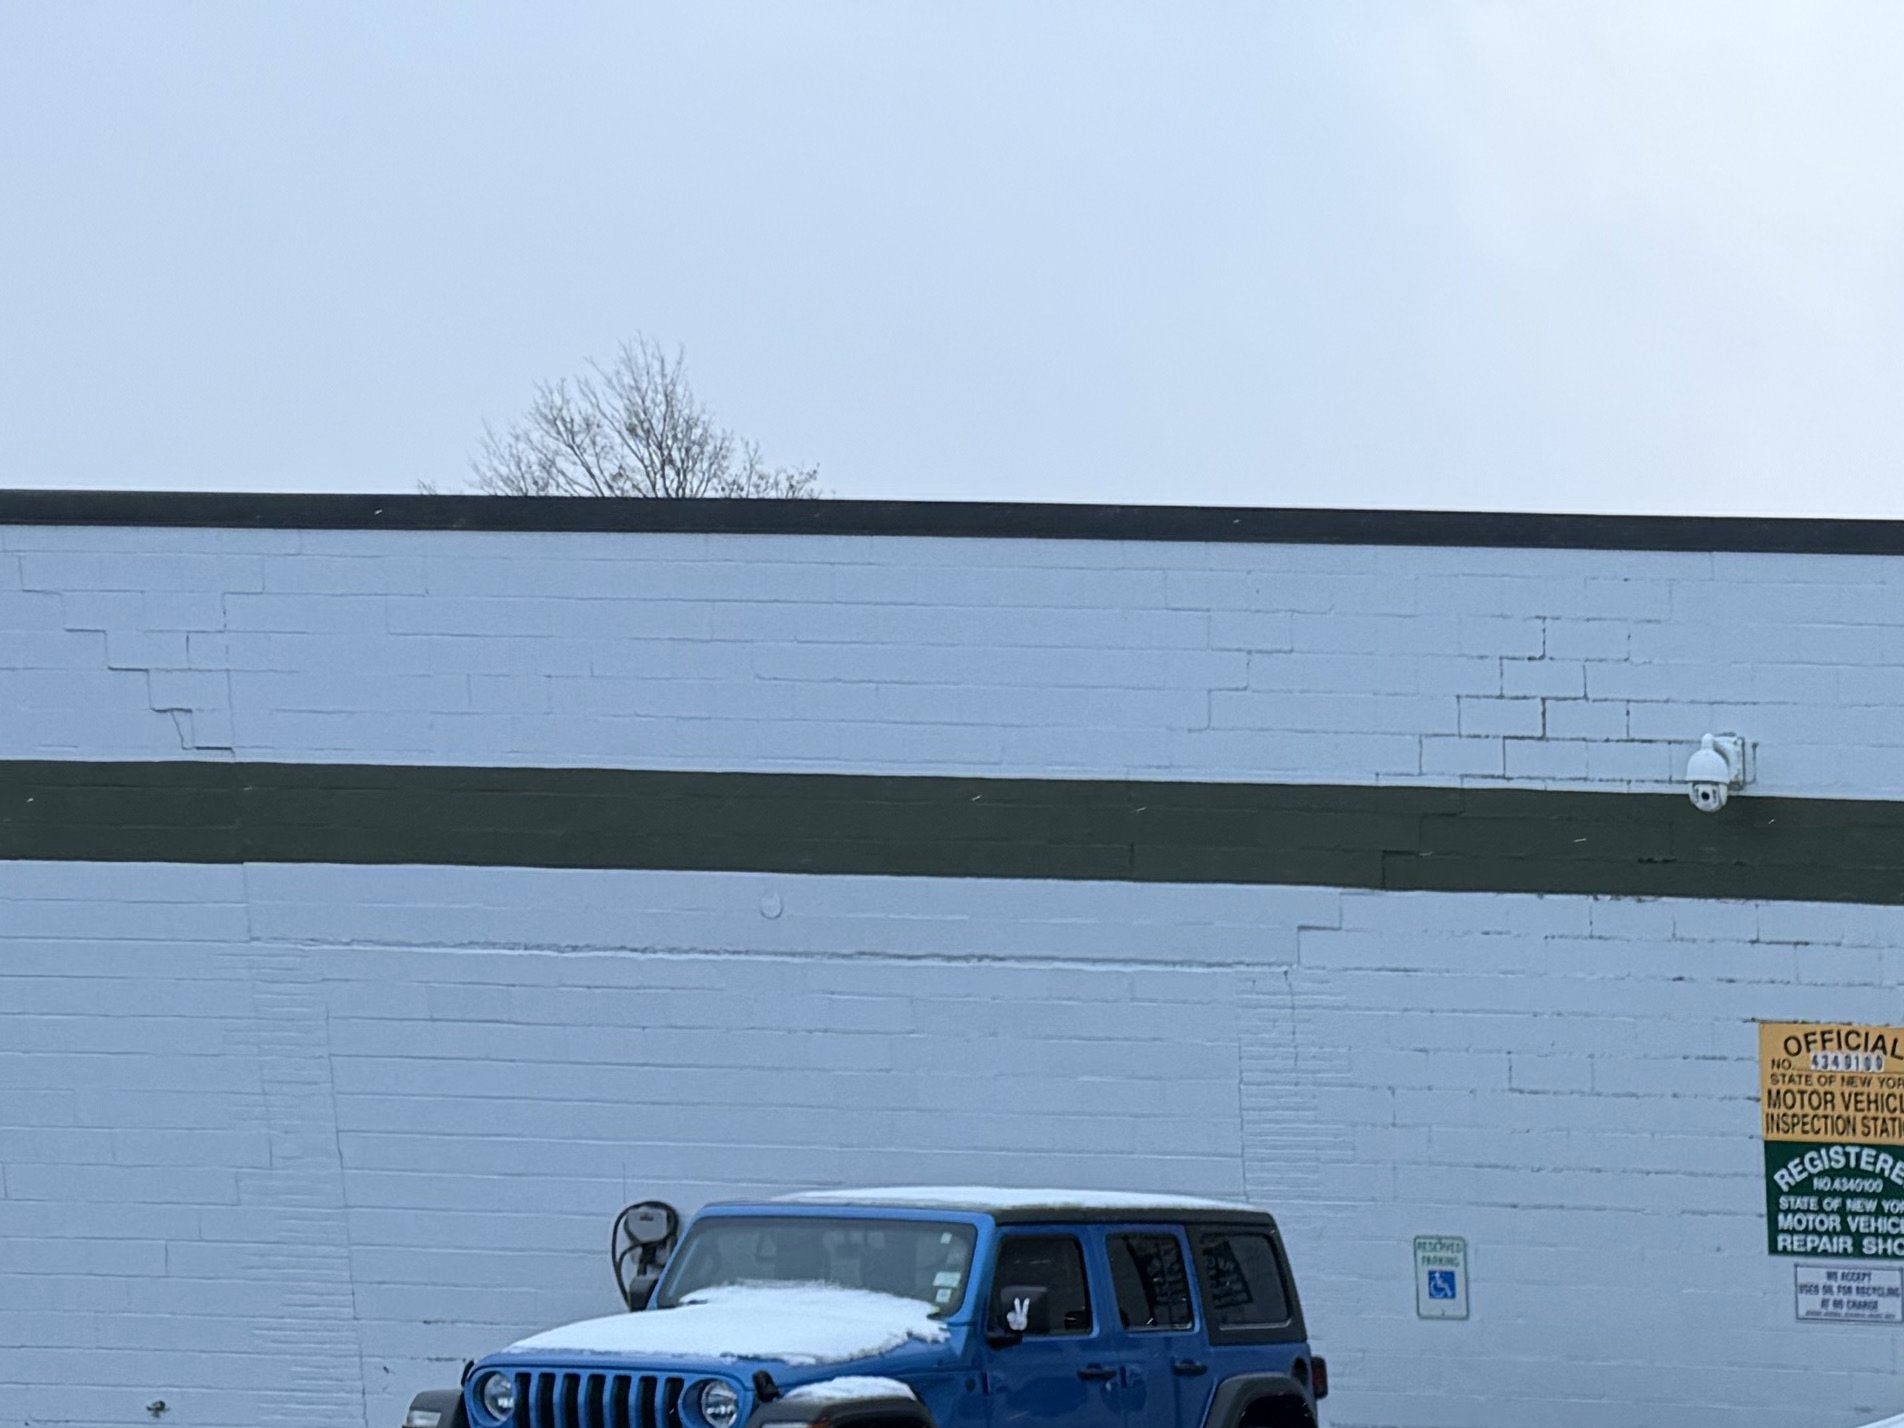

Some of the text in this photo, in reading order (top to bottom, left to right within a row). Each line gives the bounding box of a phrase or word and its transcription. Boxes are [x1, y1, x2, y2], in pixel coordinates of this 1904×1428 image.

[1783, 1029, 1904, 1061] OFFICIAL
[1811, 1054, 1884, 1071] 4340100
[1770, 1073, 1813, 1086] STATE
[1817, 1075, 1836, 1087] OF
[1840, 1076, 1873, 1089] NEW
[1767, 1088, 1836, 1112] MOTOR
[1765, 1112, 1857, 1137] INSPECTION
[1778, 1194, 1819, 1210] STATE
[1822, 1197, 1842, 1212] OF
[1845, 1198, 1878, 1213] NEW
[1777, 1211, 1842, 1232] MOTOR
[1777, 1232, 1854, 1253] REPAIR
